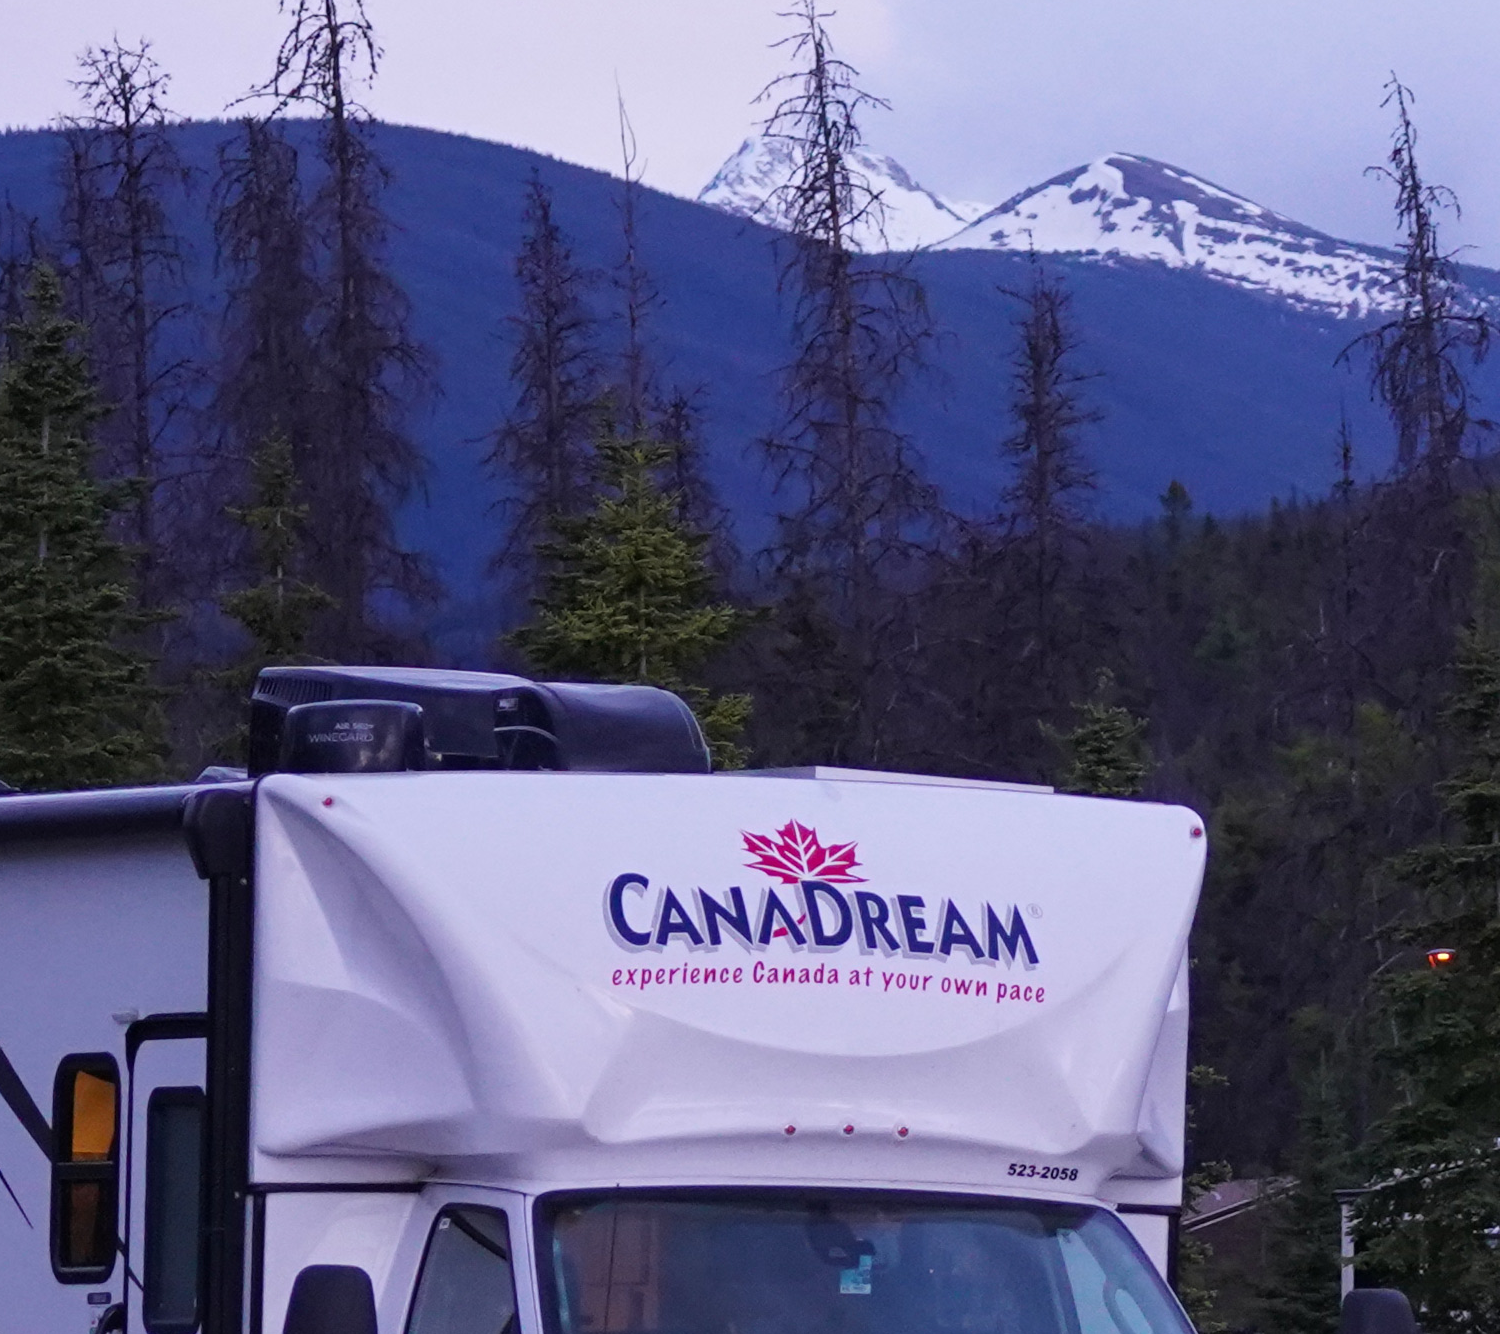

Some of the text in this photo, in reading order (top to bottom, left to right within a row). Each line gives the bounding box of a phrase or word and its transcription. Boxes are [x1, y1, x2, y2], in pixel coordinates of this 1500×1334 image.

[611, 960, 1046, 1004] experience Canada at your own pace
[1006, 1162, 1079, 1182] 523-2058
